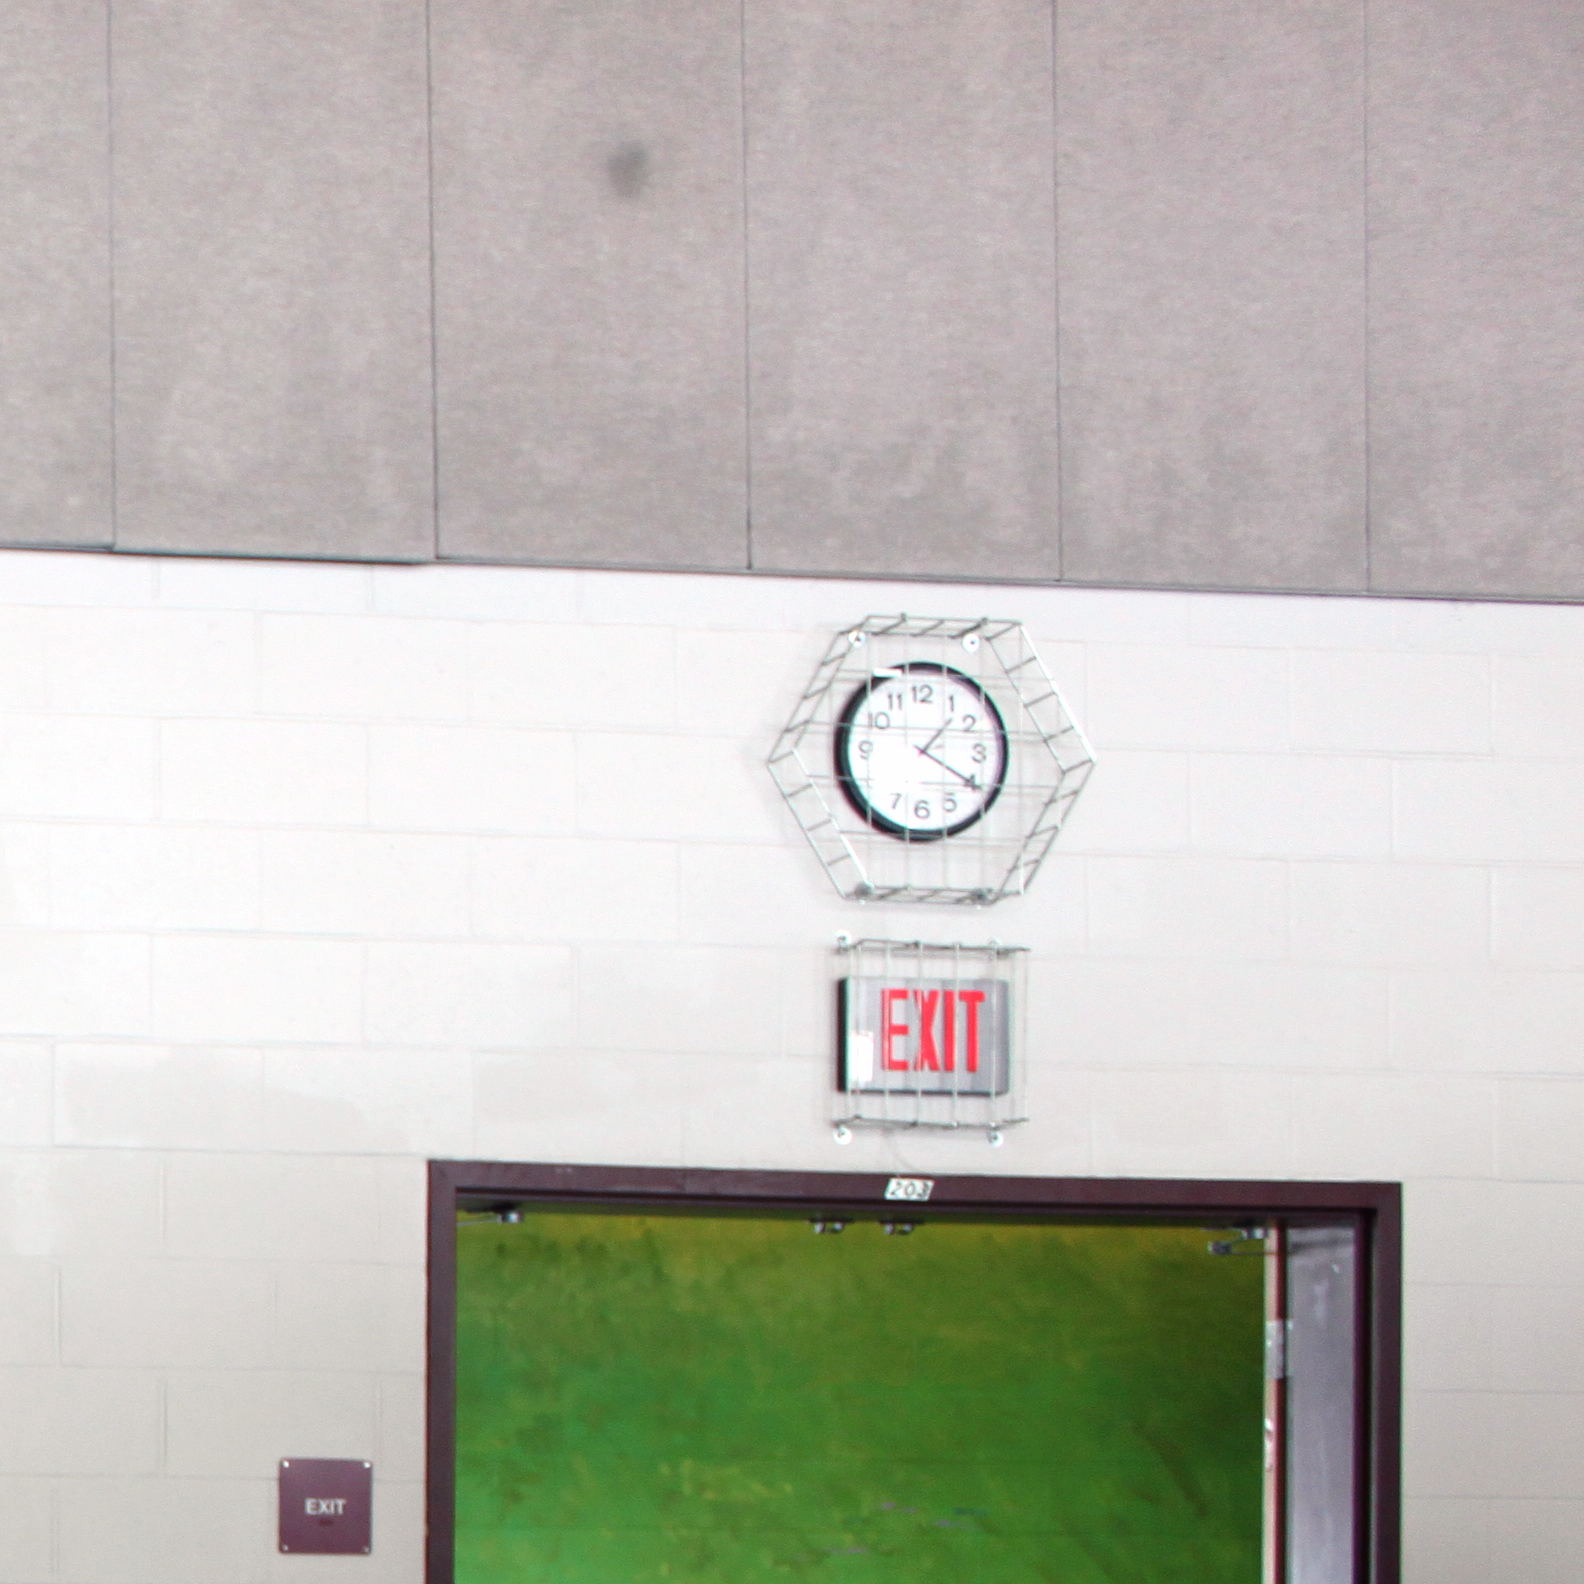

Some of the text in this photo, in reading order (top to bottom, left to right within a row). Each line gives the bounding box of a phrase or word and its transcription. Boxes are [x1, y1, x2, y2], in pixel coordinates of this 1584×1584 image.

[887, 692, 904, 711] 11
[911, 683, 933, 705] 12
[947, 695, 955, 712] 1
[866, 711, 891, 731] 10
[961, 713, 977, 733] 2
[858, 739, 874, 760] 9
[971, 742, 987, 764] 3
[889, 791, 904, 811] 7
[913, 799, 931, 820] 6
[943, 791, 958, 813] 5
[882, 988, 986, 1073] EXIT
[305, 1498, 346, 1515] EXIT
